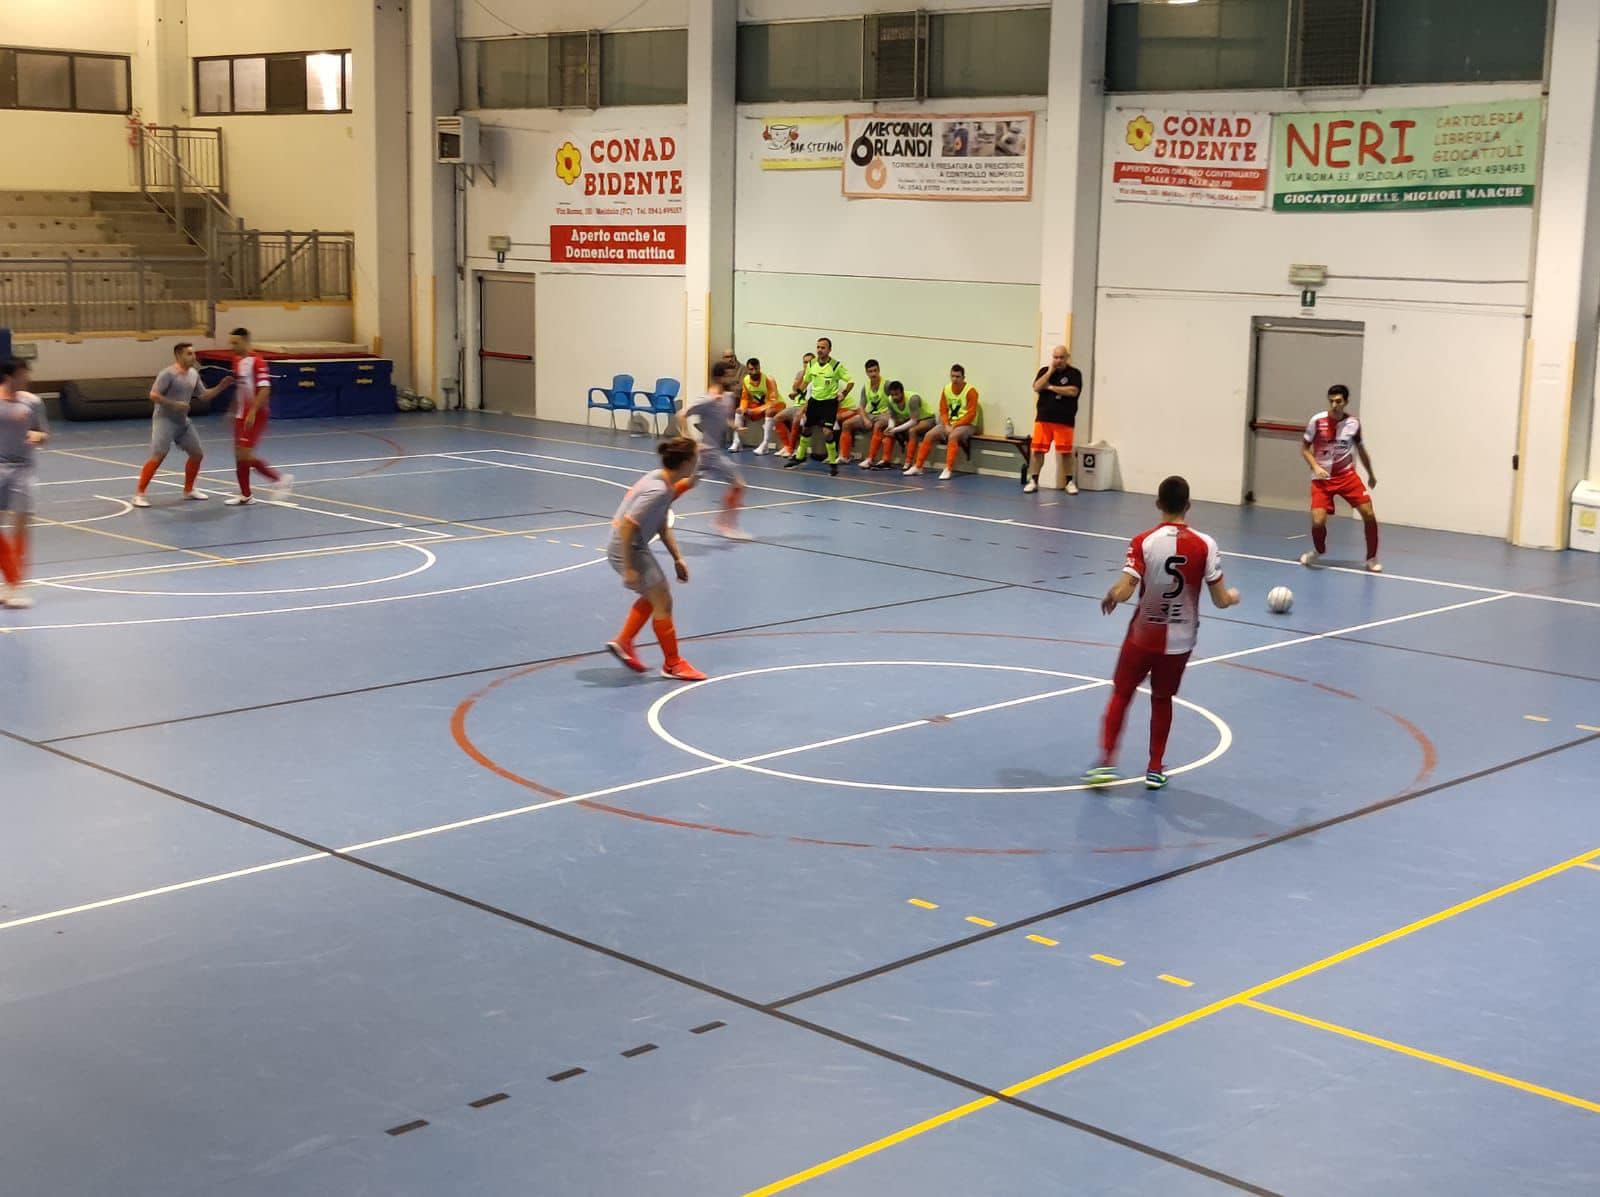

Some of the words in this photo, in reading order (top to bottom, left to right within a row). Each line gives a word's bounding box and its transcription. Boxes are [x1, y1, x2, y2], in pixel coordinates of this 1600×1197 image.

[1164, 116, 1251, 137] CONAD
[1436, 112, 1523, 128] CARTOLERIA
[863, 122, 932, 137] MECCANICA
[790, 142, 805, 153] BAR
[807, 141, 844, 153] STEFANO
[1287, 120, 1417, 168] NERI
[1434, 131, 1500, 146] LIBRERIA
[590, 137, 675, 163] CONAD
[851, 136, 932, 166] ORLANDI
[1154, 139, 1257, 161] BIDENTE
[1433, 145, 1524, 162] GIOCATTOLI
[584, 170, 682, 196] BIDENTE
[1285, 173, 1302, 182] VIA
[1306, 172, 1333, 181] ROMA
[1358, 170, 1403, 181] MELDOLA
[1284, 193, 1357, 204] GIOCATTOLI
[1359, 191, 1399, 203] DELLE
[1403, 189, 1461, 201] MIGLIORI
[1465, 187, 1523, 199] MARCHE
[571, 229, 610, 243] Aperto
[613, 229, 649, 242] anche
[653, 229, 666, 242] la
[565, 245, 624, 259] Domenica
[627, 246, 675, 260] mattina
[1162, 555, 1187, 598] 5
